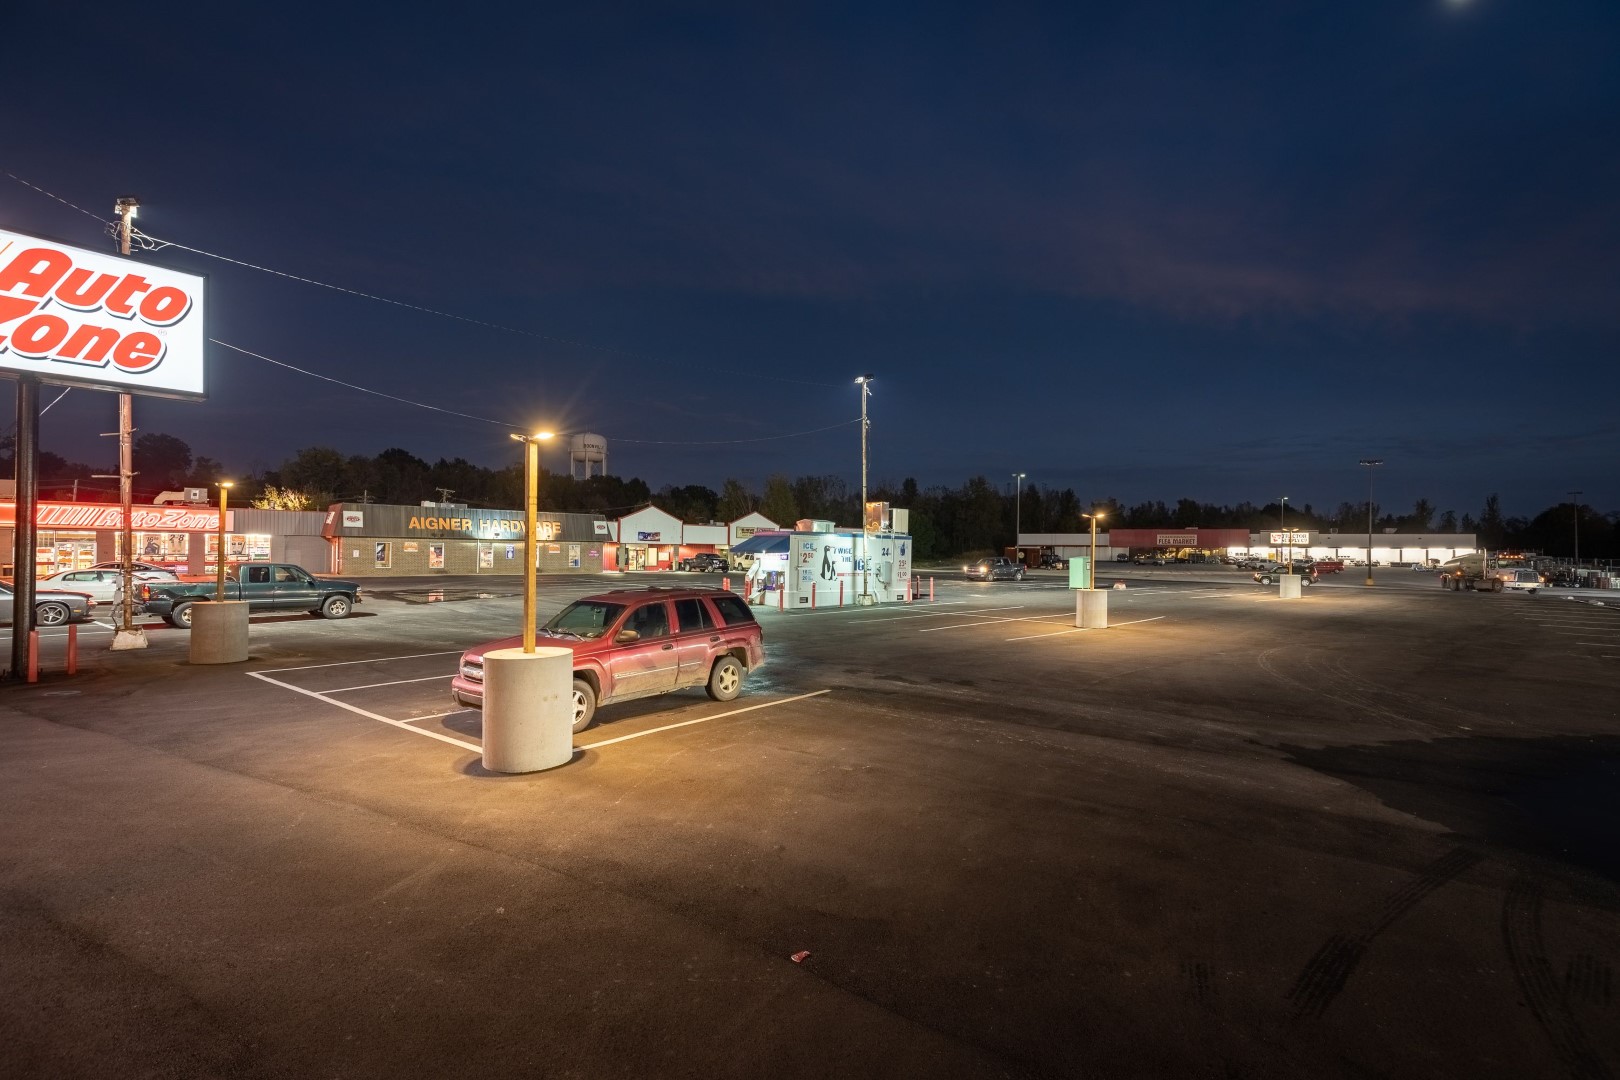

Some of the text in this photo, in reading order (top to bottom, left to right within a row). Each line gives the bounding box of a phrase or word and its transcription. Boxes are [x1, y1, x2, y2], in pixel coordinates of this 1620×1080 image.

[0, 248, 190, 325] Auto
[96, 508, 220, 530] AtoZone
[408, 516, 562, 533] AIGNER HARDARE
